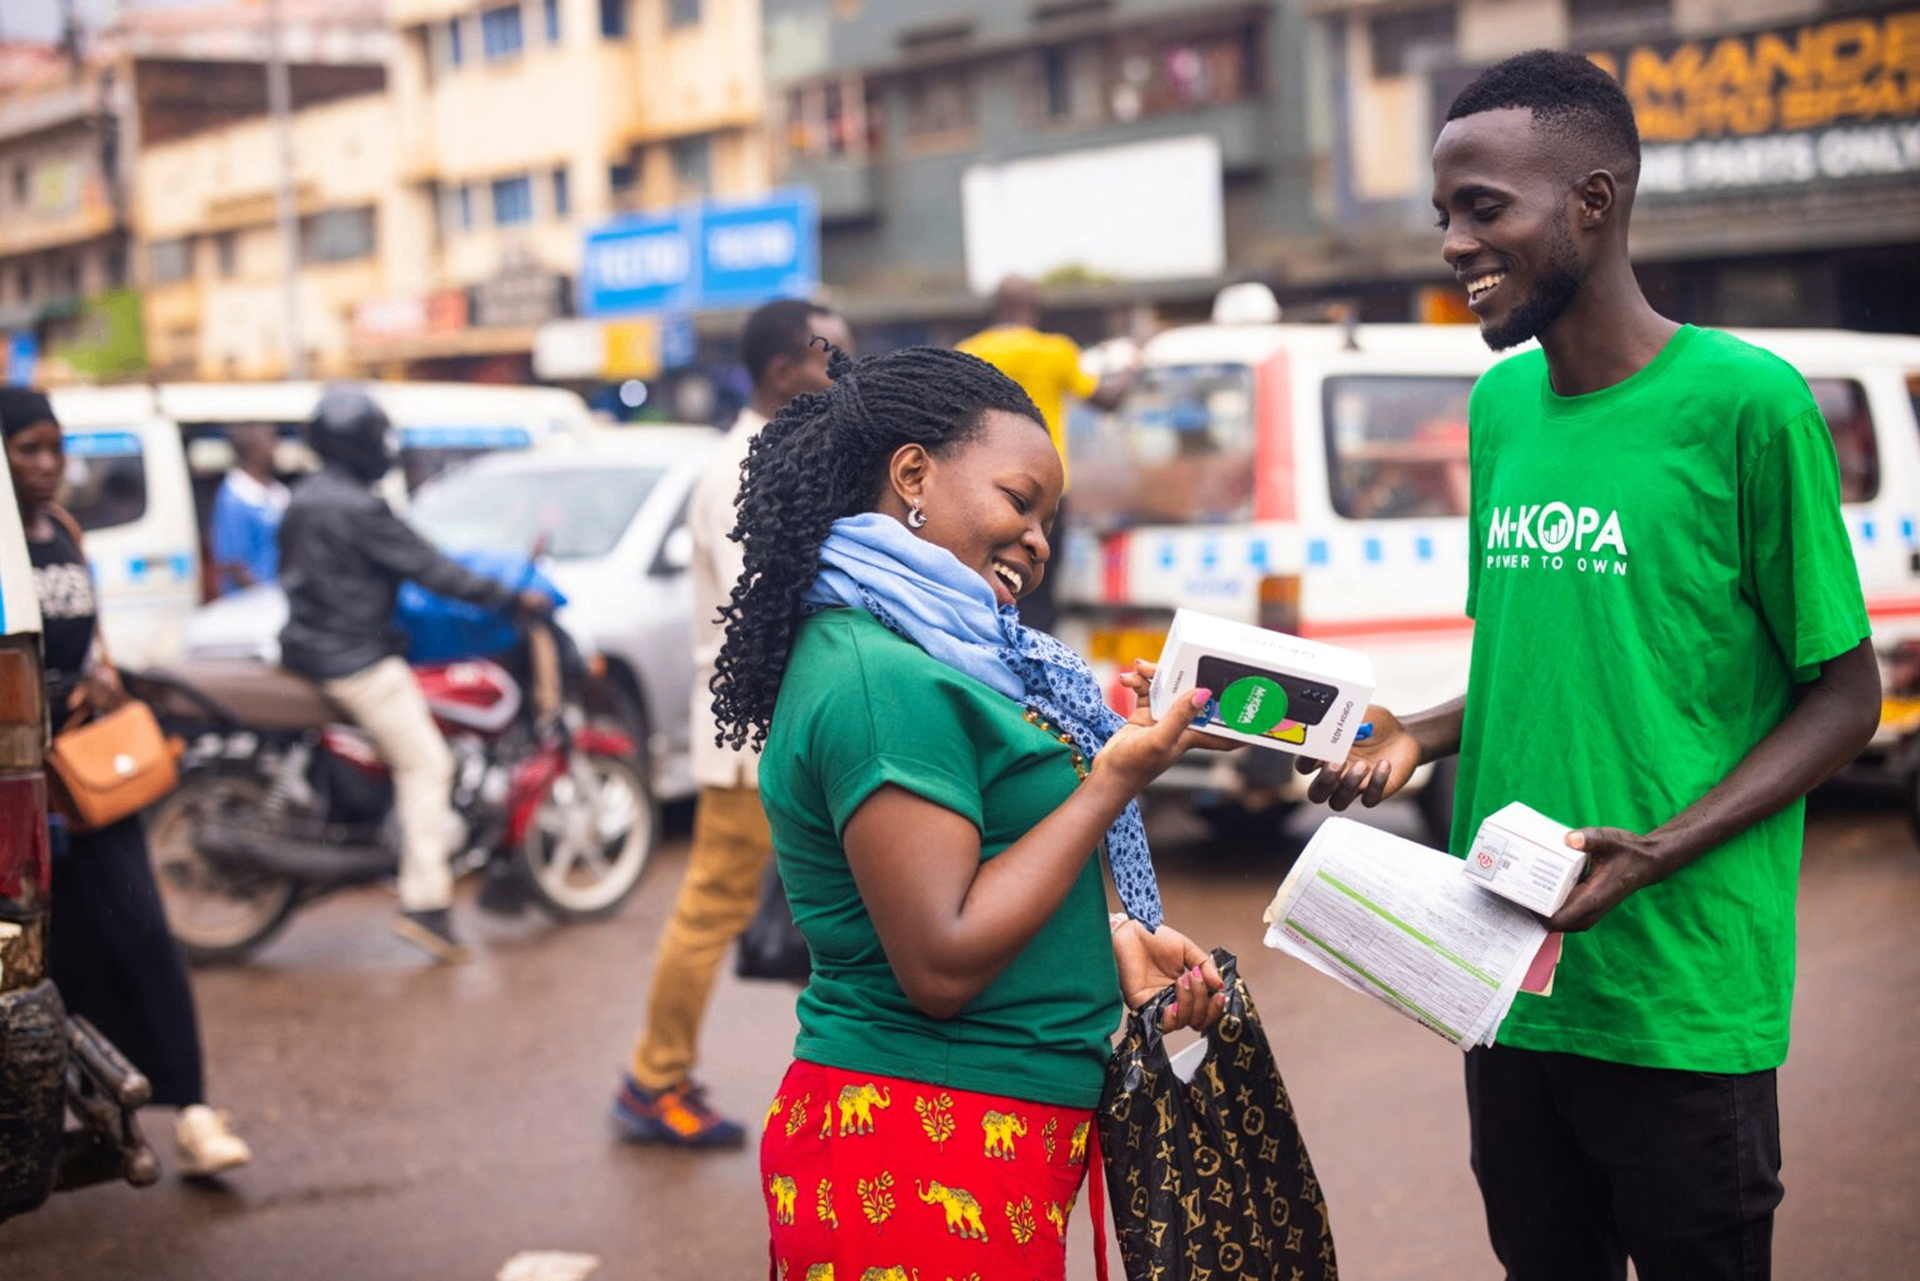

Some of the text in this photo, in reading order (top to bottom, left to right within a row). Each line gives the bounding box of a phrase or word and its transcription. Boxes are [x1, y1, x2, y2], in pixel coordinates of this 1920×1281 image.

[1487, 501, 1627, 555] M-KOPA
[1487, 555, 1628, 576] POWER TO OWN
